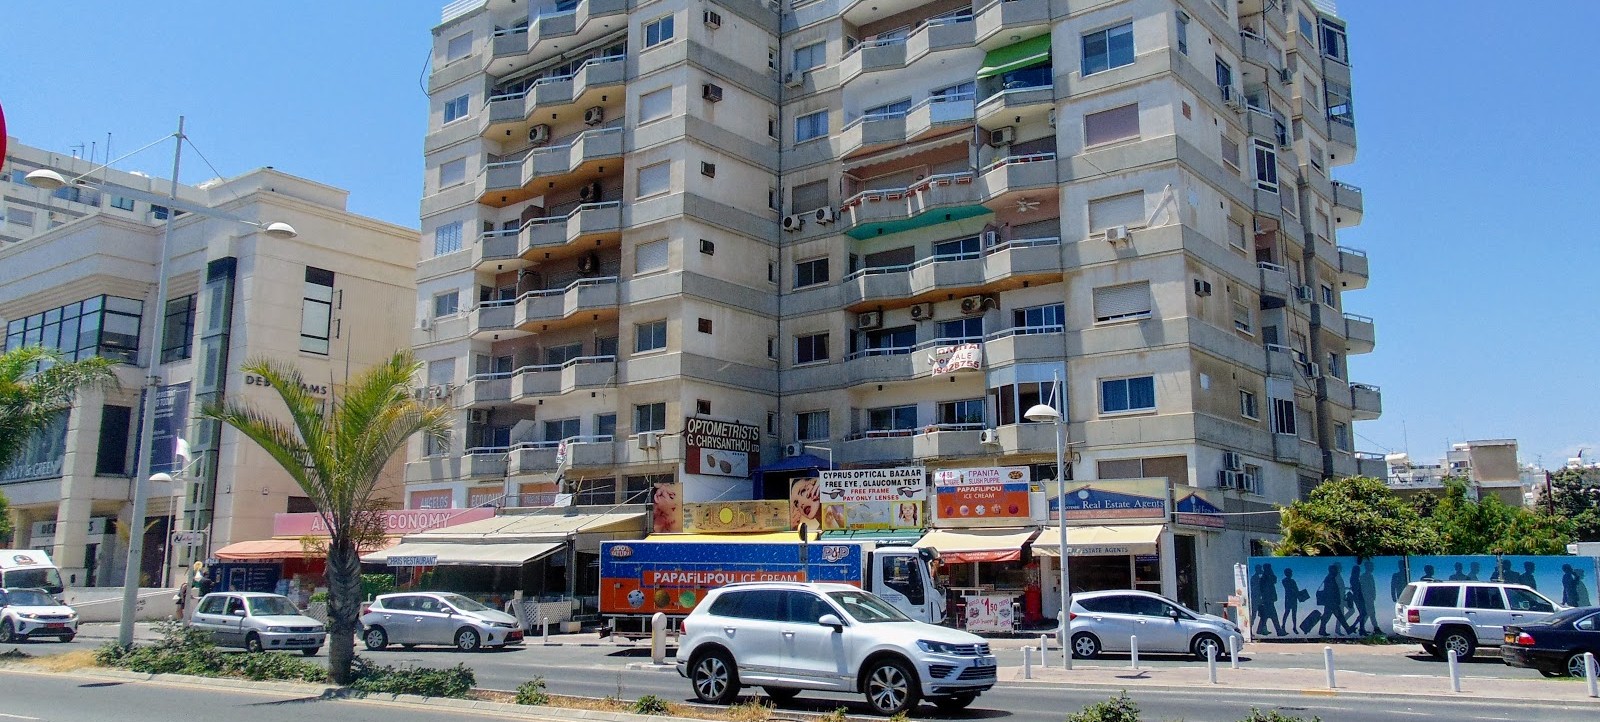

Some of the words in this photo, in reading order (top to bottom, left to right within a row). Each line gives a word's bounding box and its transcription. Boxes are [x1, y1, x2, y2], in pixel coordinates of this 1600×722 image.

[246, 375, 327, 395] DEBAMS
[687, 418, 759, 441] OPTOMETRISTS
[696, 434, 751, 452] CHRYSANTHOU
[823, 471, 852, 479] CYPRUS
[853, 470, 887, 479] OPTICAL
[889, 469, 922, 478] BAZAAR
[862, 479, 902, 487] GLAUCOMA
[903, 478, 921, 486] TEST
[1082, 500, 1101, 509] Real
[1105, 500, 1131, 509] Estate
[1134, 500, 1165, 510] Agents
[403, 556, 437, 566] RESTAURANT
[741, 574, 755, 582] ICE
[761, 574, 797, 582] CREAM
